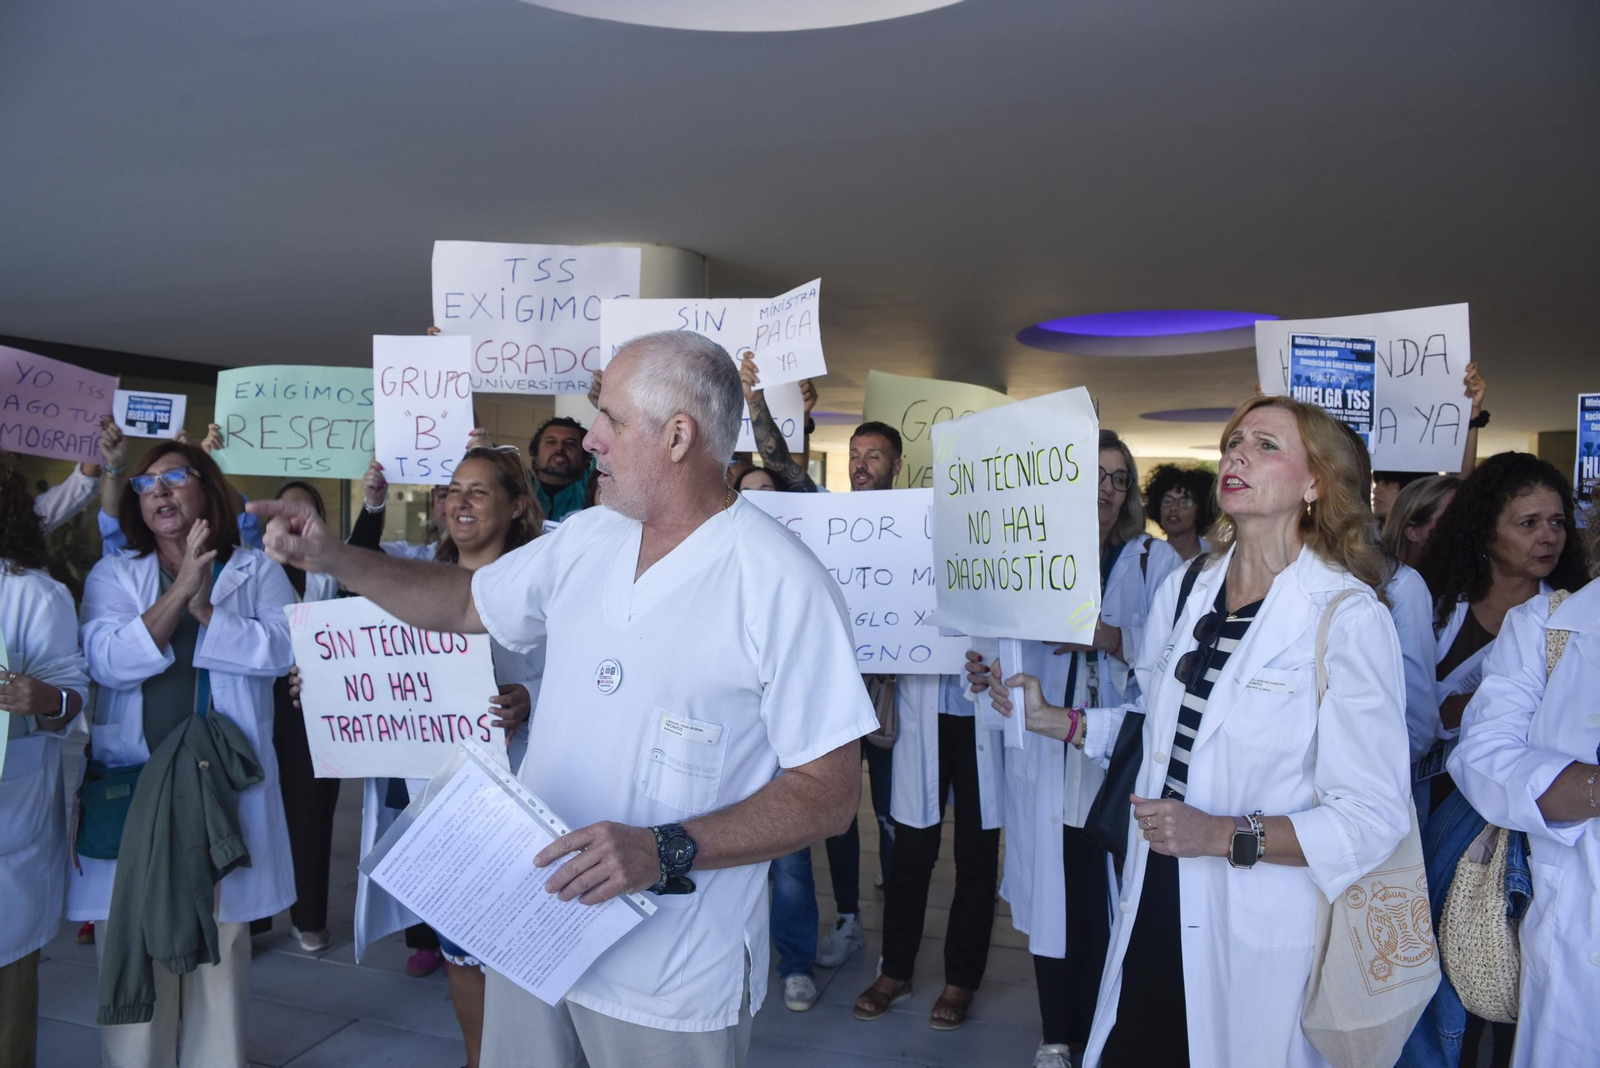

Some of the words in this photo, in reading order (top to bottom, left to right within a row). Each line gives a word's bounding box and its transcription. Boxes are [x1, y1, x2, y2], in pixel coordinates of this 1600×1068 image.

[504, 257, 576, 284] TSS
[445, 287, 630, 323] EXIGIMO
[677, 303, 727, 332] SIN
[759, 287, 817, 320] MINISTRA
[754, 310, 812, 352] PAGA
[776, 352, 799, 372] YA
[16, 361, 54, 388] YO
[77, 380, 105, 400] TSS
[235, 377, 374, 407] EXIGIMOS
[381, 366, 472, 399] GRUPO
[1294, 386, 1343, 408] HUELGA
[1346, 389, 1370, 410] TSS
[127, 410, 155, 422] HUELGA
[156, 411, 170, 423] TSS
[1414, 403, 1460, 446] YA
[278, 457, 331, 472] TSS
[948, 457, 975, 496] SIN
[981, 441, 1079, 492] TÉCNICOS
[827, 515, 902, 545] POR
[968, 510, 991, 545] NO
[1002, 504, 1047, 544] HAY
[947, 550, 1077, 592] DIAGNÓSTICO
[314, 623, 356, 660] SIN
[360, 619, 468, 657] TÉCNICOS
[344, 672, 375, 702] NO
[388, 672, 433, 702] HAY
[321, 708, 491, 744] TRATAMIENTOS
